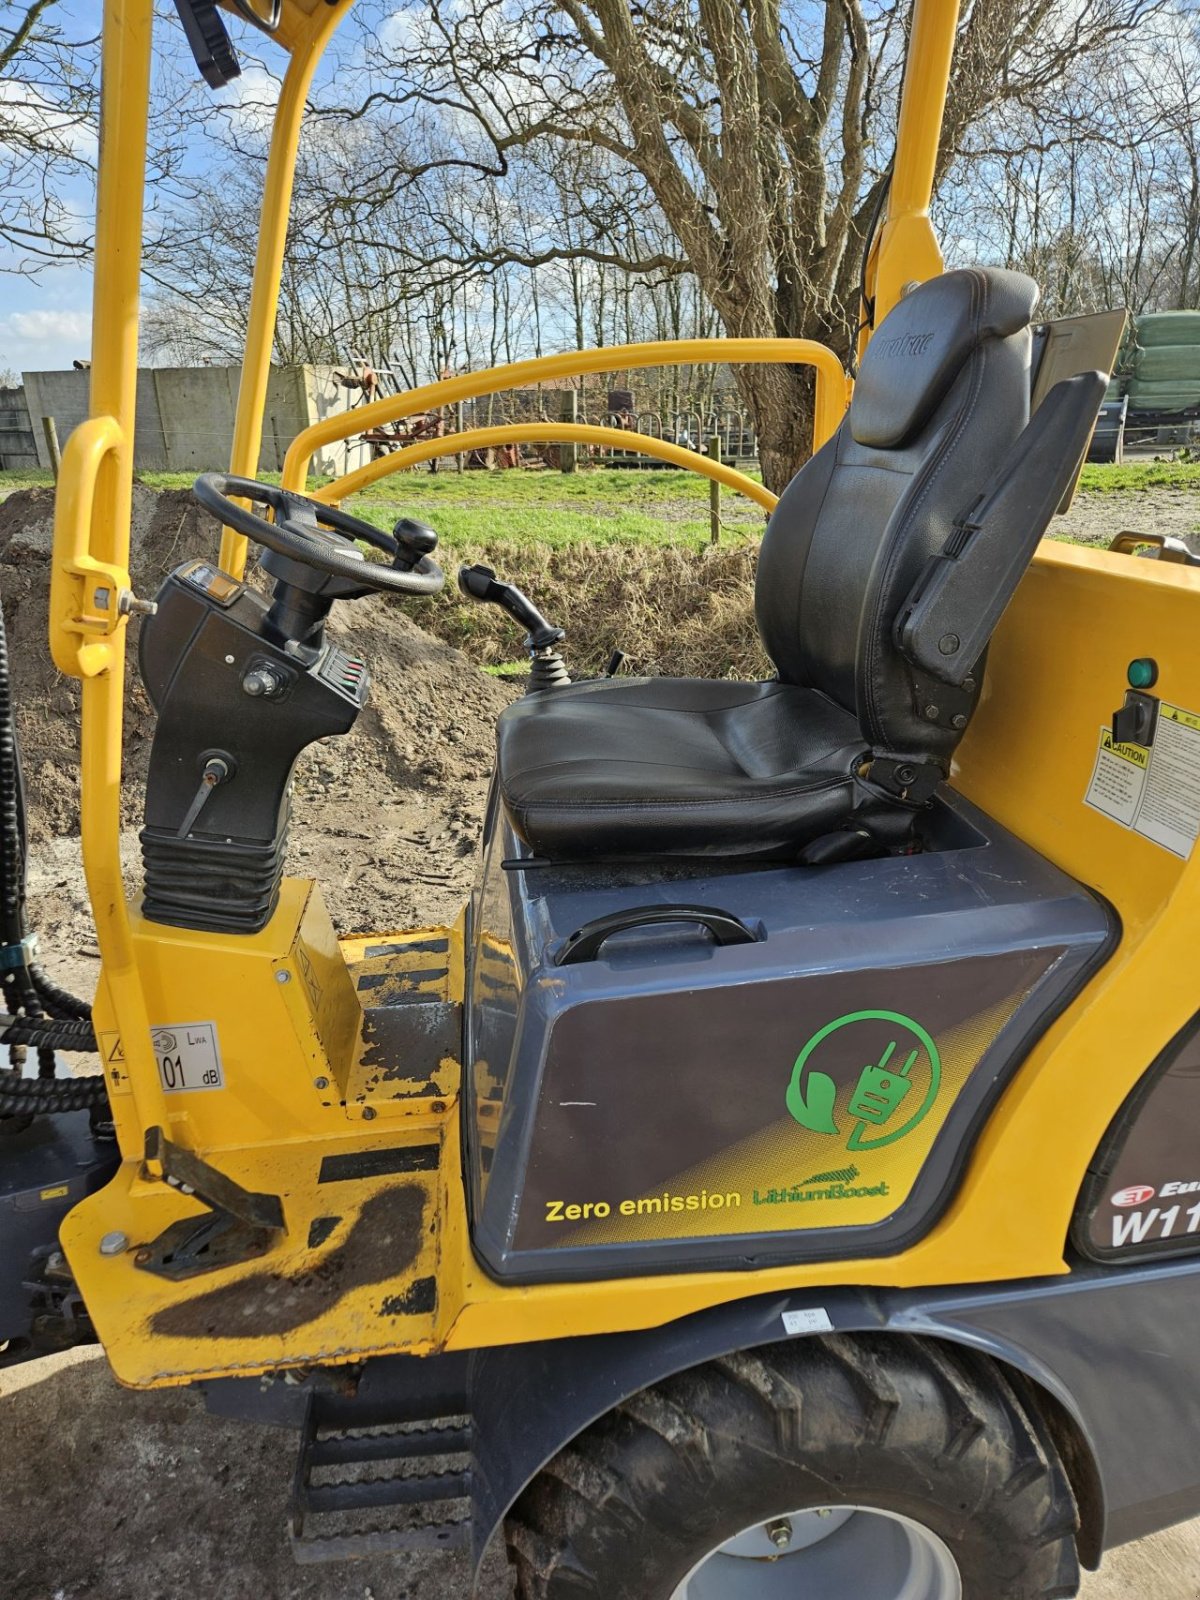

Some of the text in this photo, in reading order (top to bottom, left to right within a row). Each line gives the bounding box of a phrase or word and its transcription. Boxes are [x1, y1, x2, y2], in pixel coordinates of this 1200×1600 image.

[1112, 742, 1146, 764] CAUTION
[202, 1069, 218, 1085] dB
[545, 1189, 741, 1222] Zero emission
[752, 1182, 890, 1206] LithiumBoost
[1112, 1202, 1200, 1248] W11
